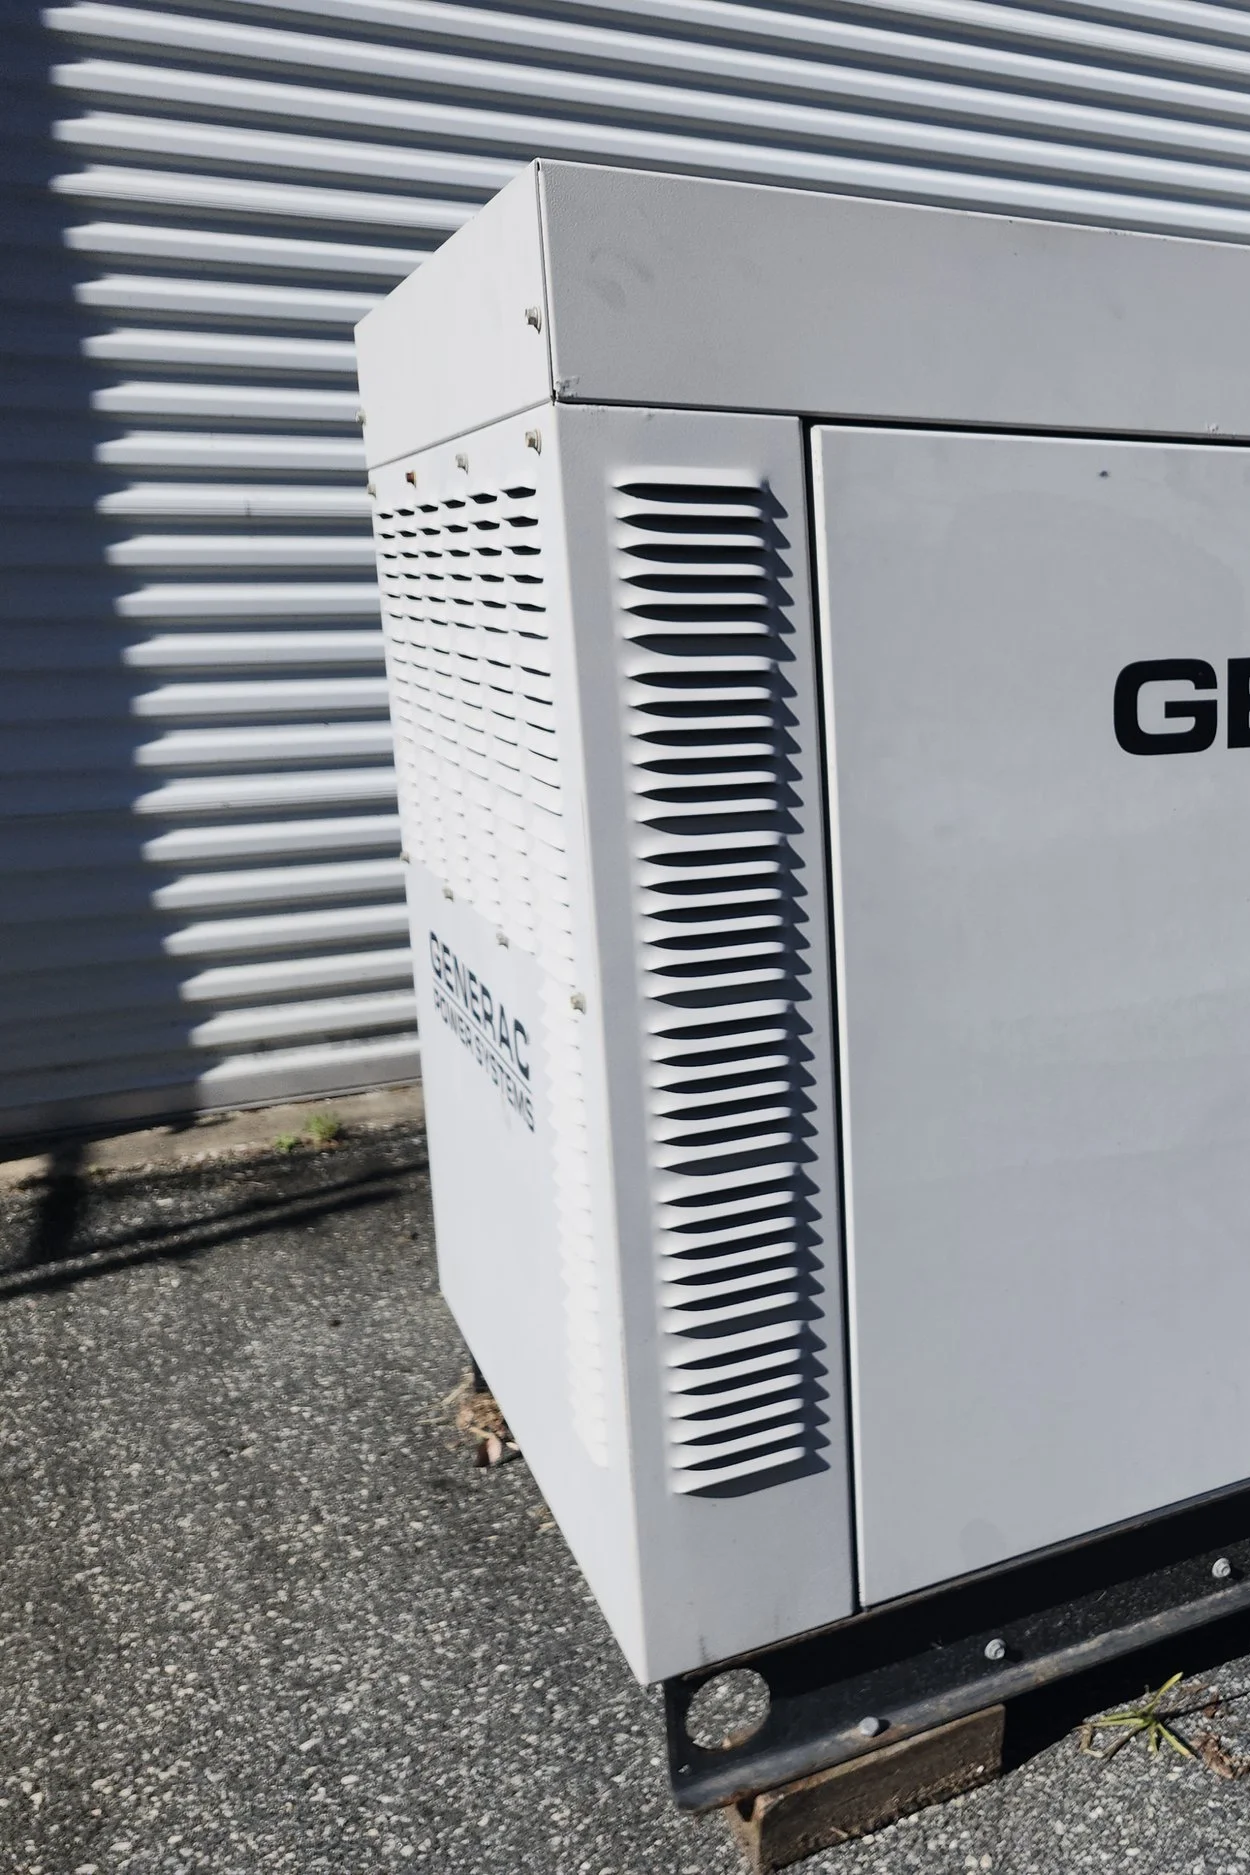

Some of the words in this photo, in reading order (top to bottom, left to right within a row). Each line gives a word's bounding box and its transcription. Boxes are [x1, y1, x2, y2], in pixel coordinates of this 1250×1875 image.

[430, 930, 530, 1081] GENERAC
[433, 986, 474, 1055] POWER
[474, 1033, 535, 1133] SYSTEMS
